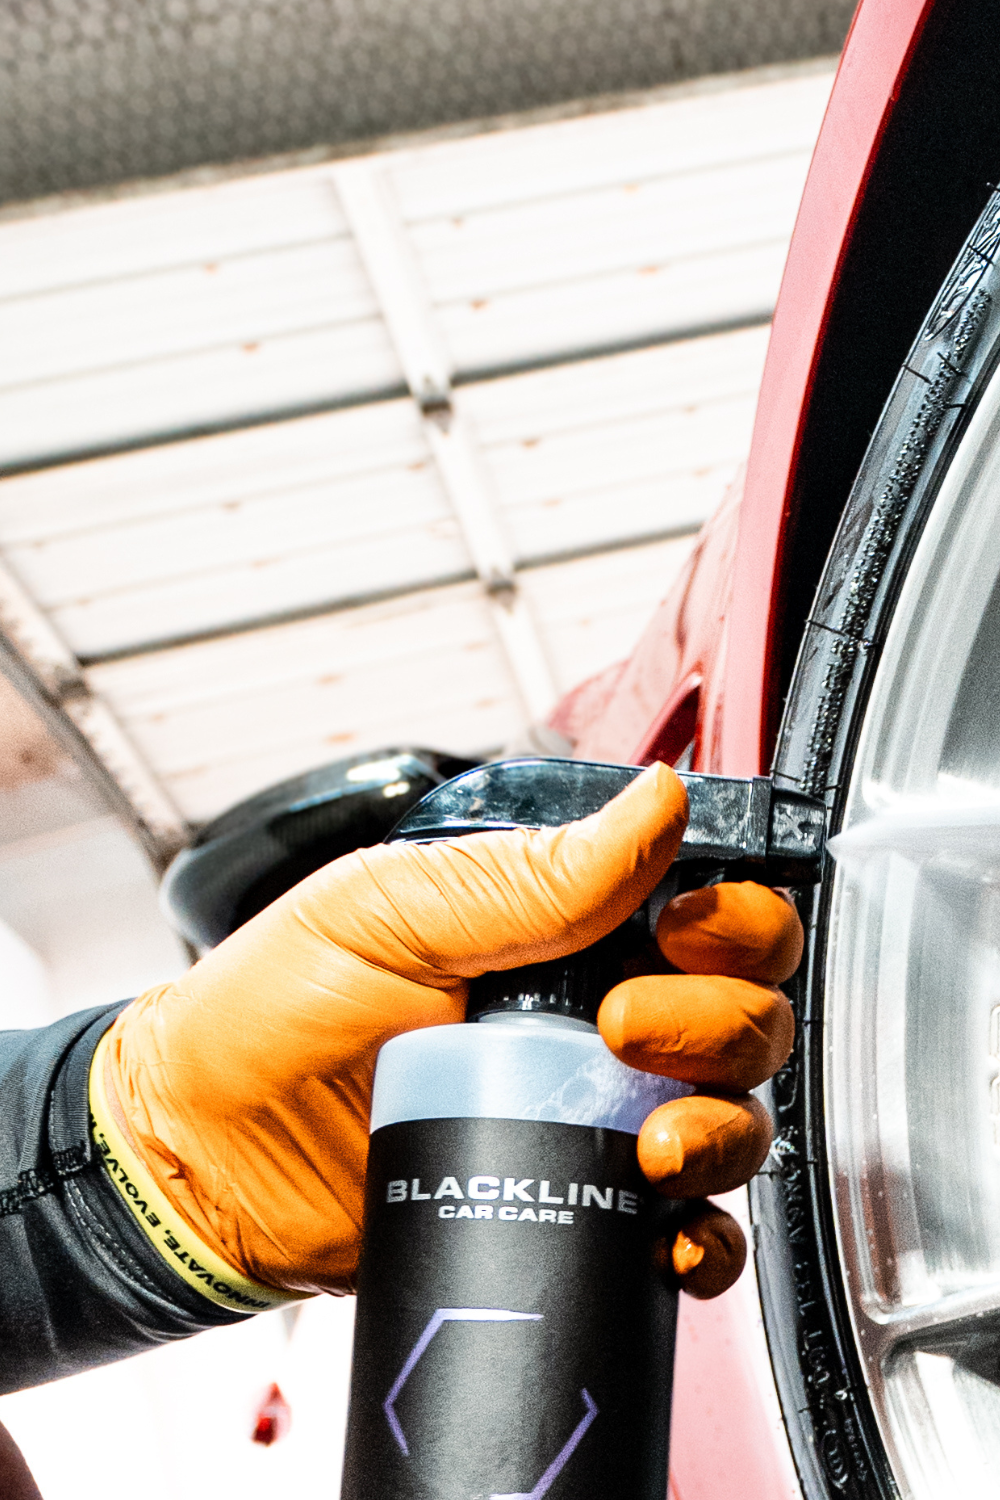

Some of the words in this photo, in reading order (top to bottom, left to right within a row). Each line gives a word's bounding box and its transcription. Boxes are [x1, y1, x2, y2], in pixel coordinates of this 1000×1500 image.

[386, 1175, 640, 1215] BLACKLINE
[438, 1205, 493, 1220] CAR
[498, 1206, 574, 1225] CARE
